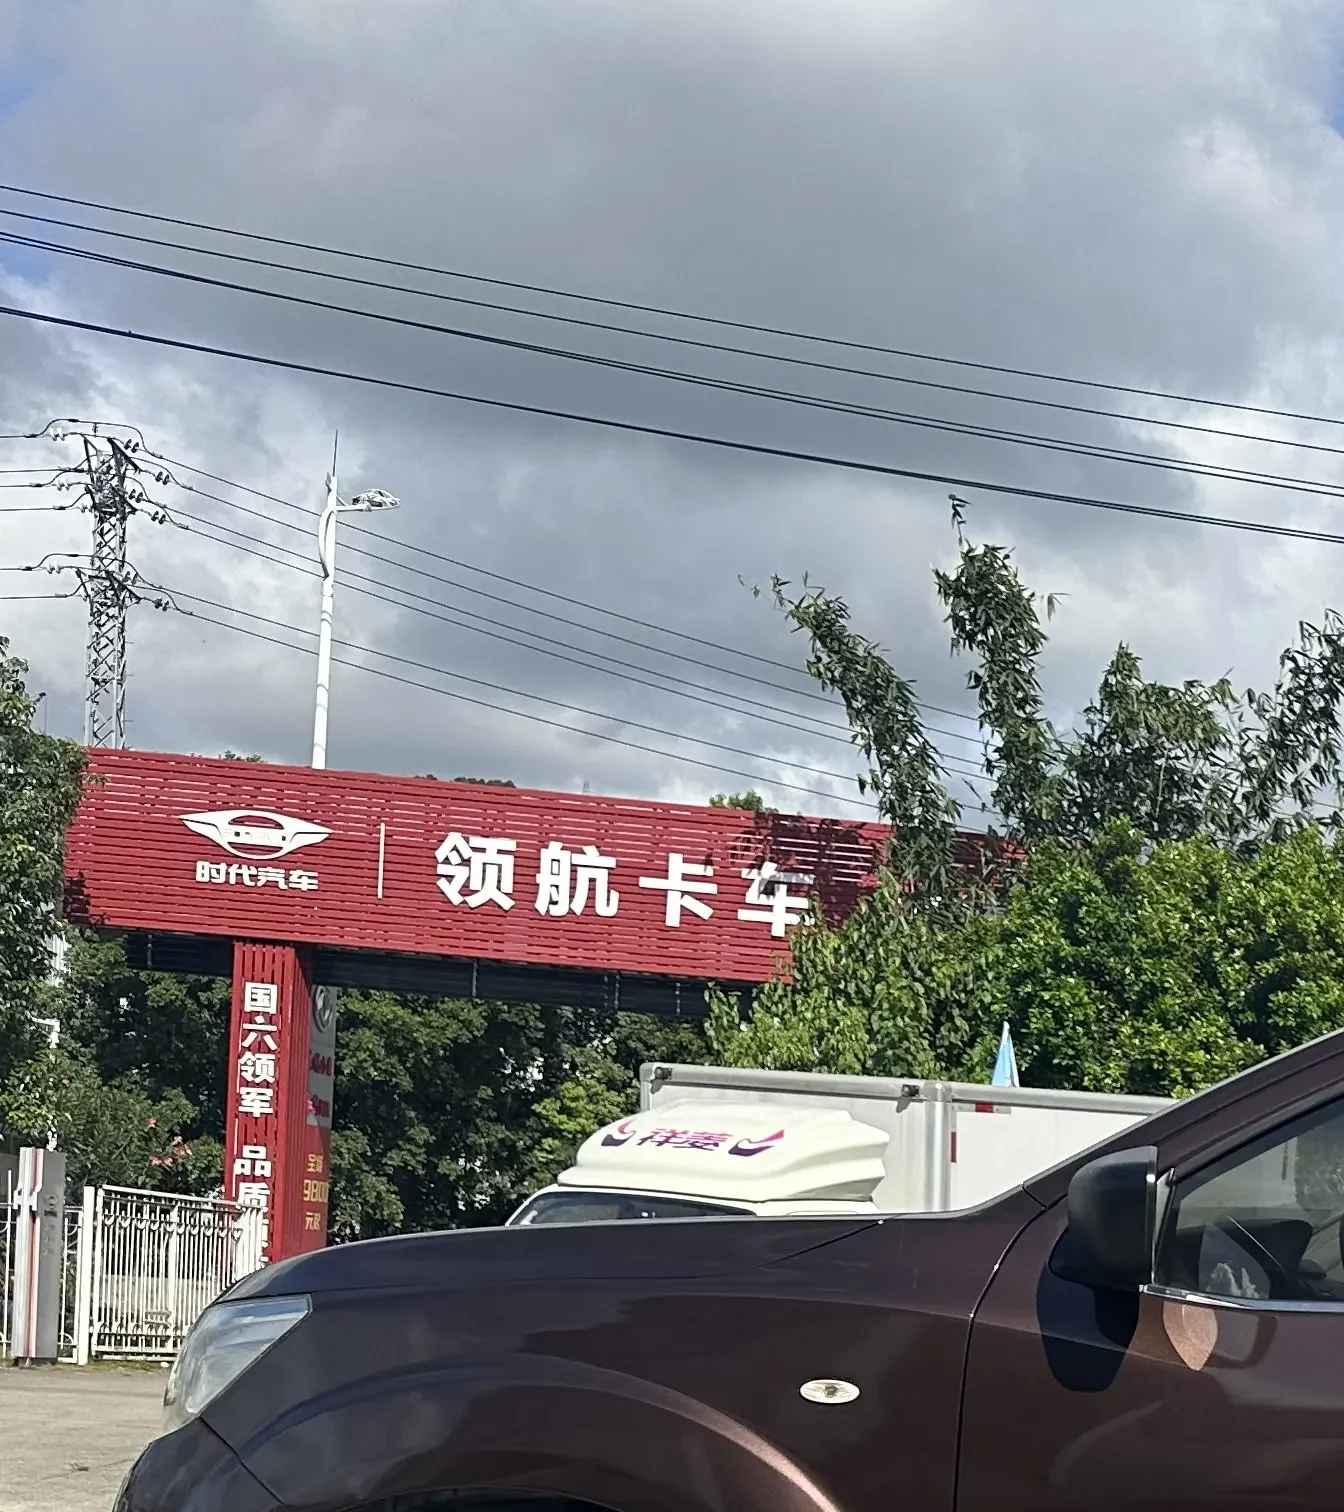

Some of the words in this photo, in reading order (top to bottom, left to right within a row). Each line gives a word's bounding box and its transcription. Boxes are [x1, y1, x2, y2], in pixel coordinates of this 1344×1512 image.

[195, 860, 319, 891] 时代汽车
[434, 831, 815, 938] 领航卡车
[238, 981, 278, 1118] 国六领军
